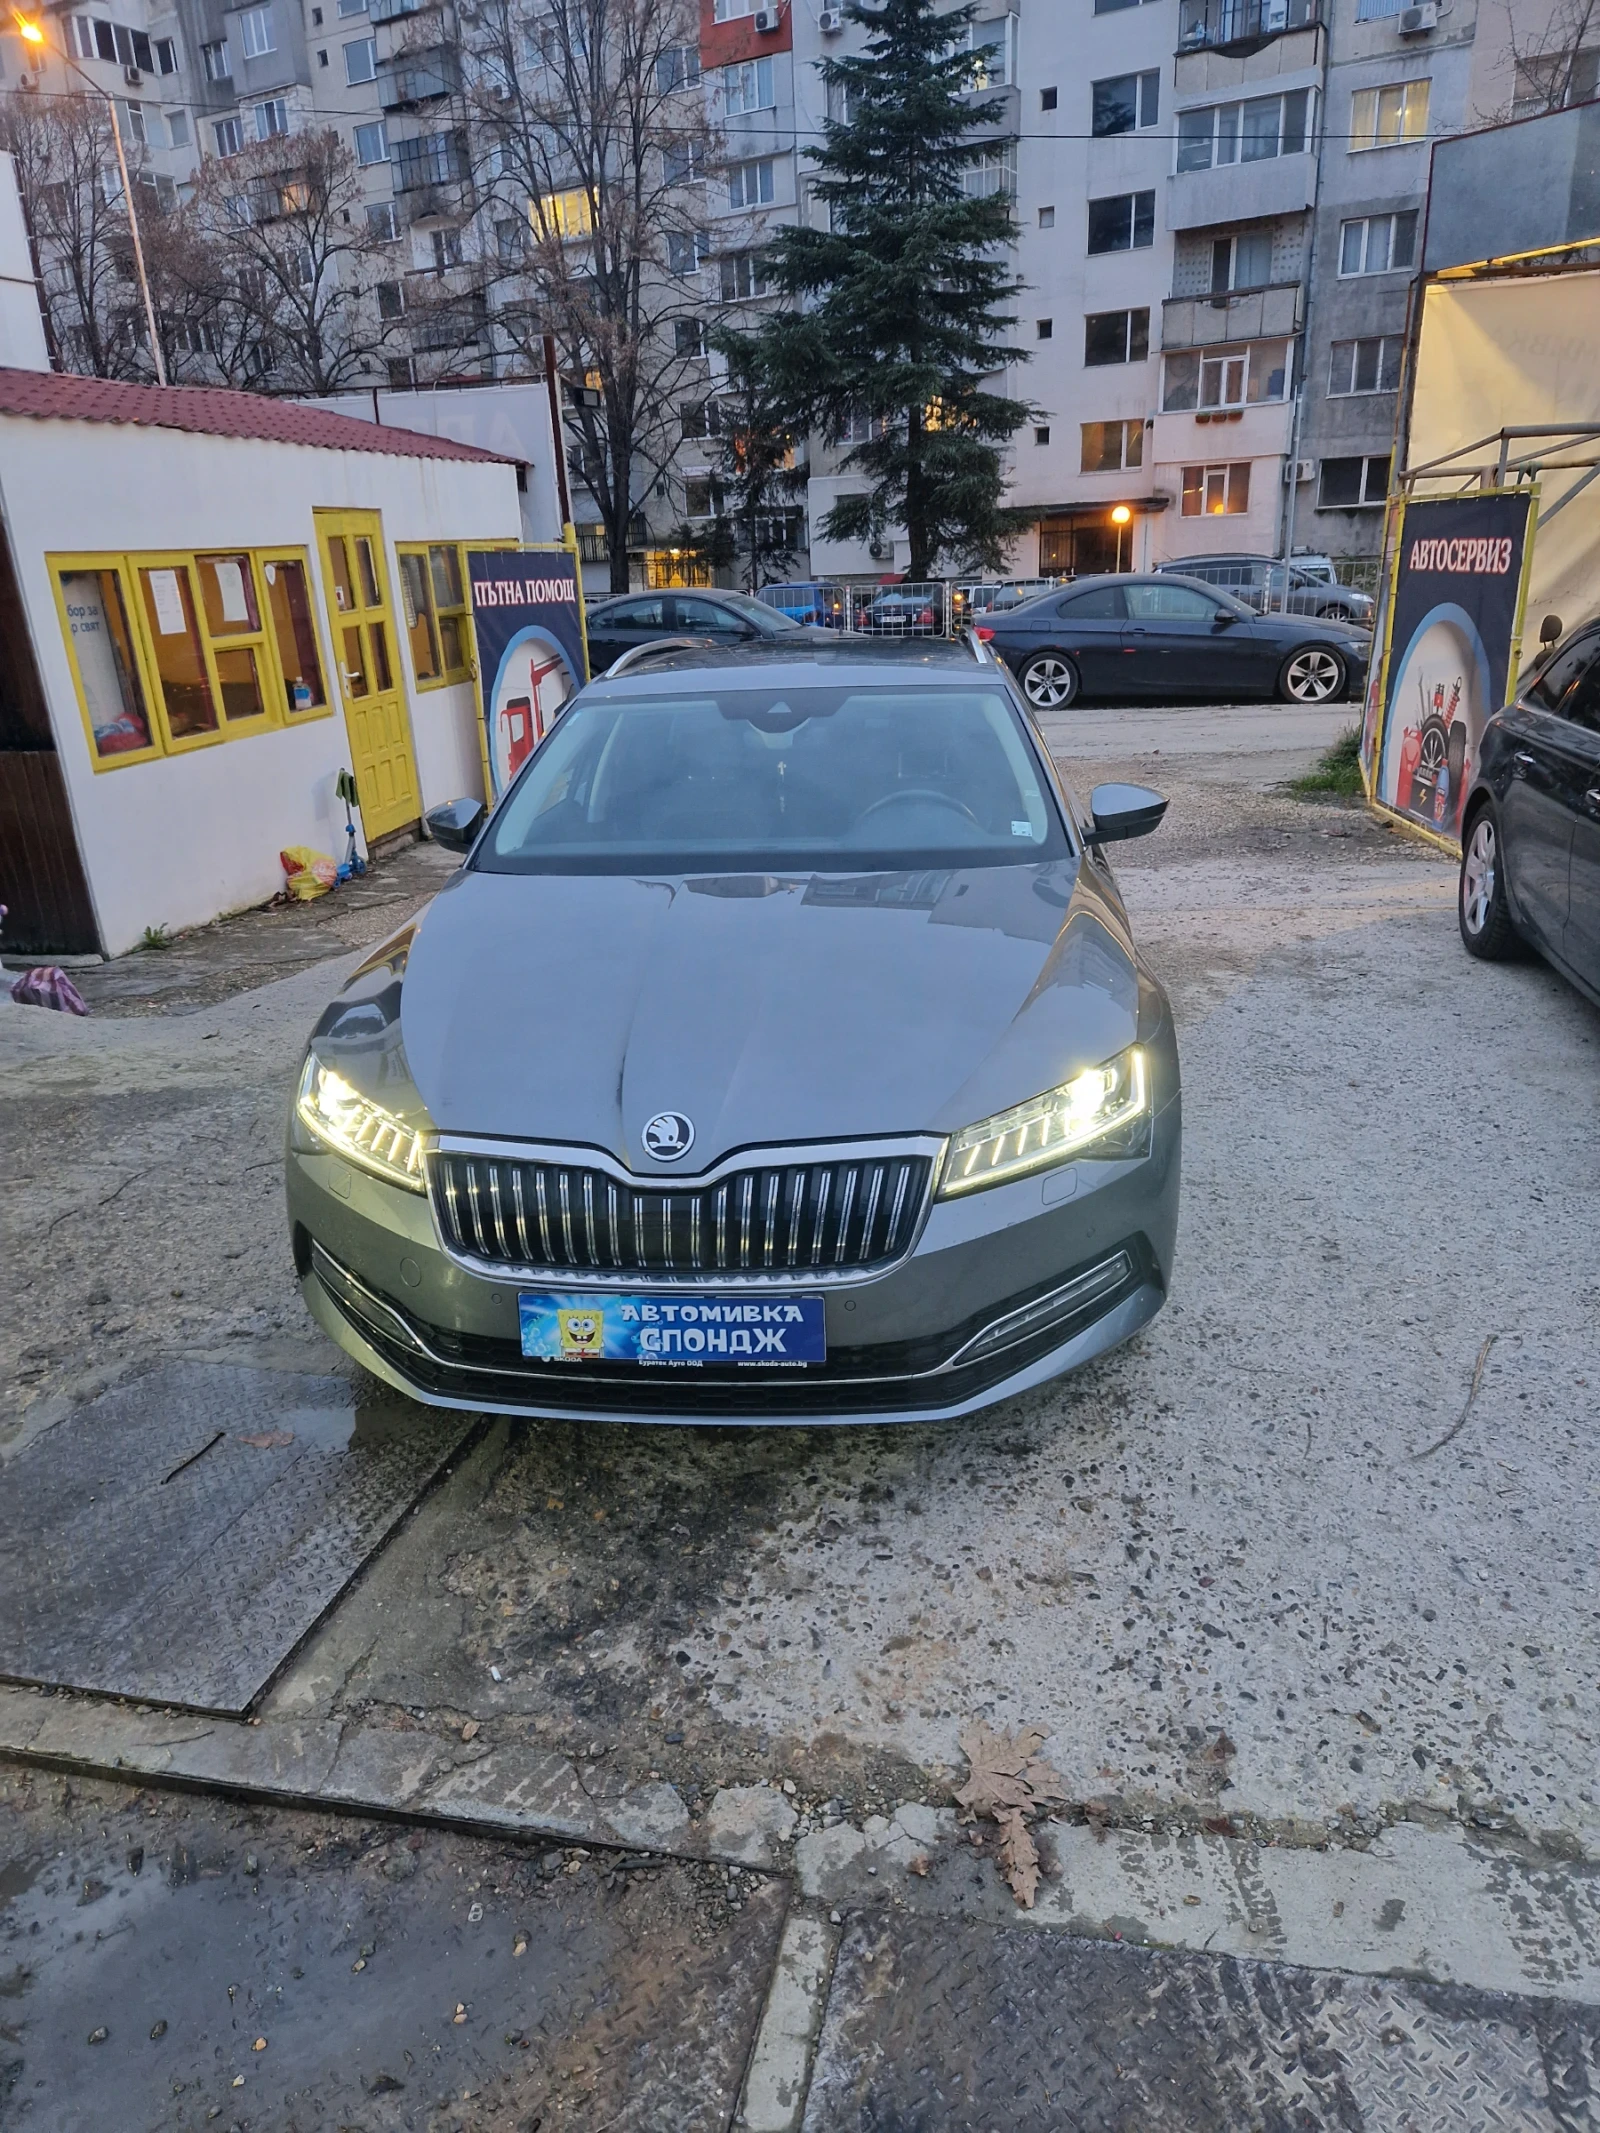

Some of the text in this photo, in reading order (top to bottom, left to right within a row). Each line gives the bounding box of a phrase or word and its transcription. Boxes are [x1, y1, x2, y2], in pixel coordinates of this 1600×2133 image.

[1409, 537, 1513, 574] АВТОСЕРВИЗ
[473, 579, 576, 607] ПЪТНА ПОМОЩ
[620, 1304, 804, 1323] АВТОМИВКА
[639, 1327, 788, 1355] СПОНДЖ
[668, 1359, 686, 1368] Ауто
[737, 1360, 808, 1369] www.skoda-auto.bg
